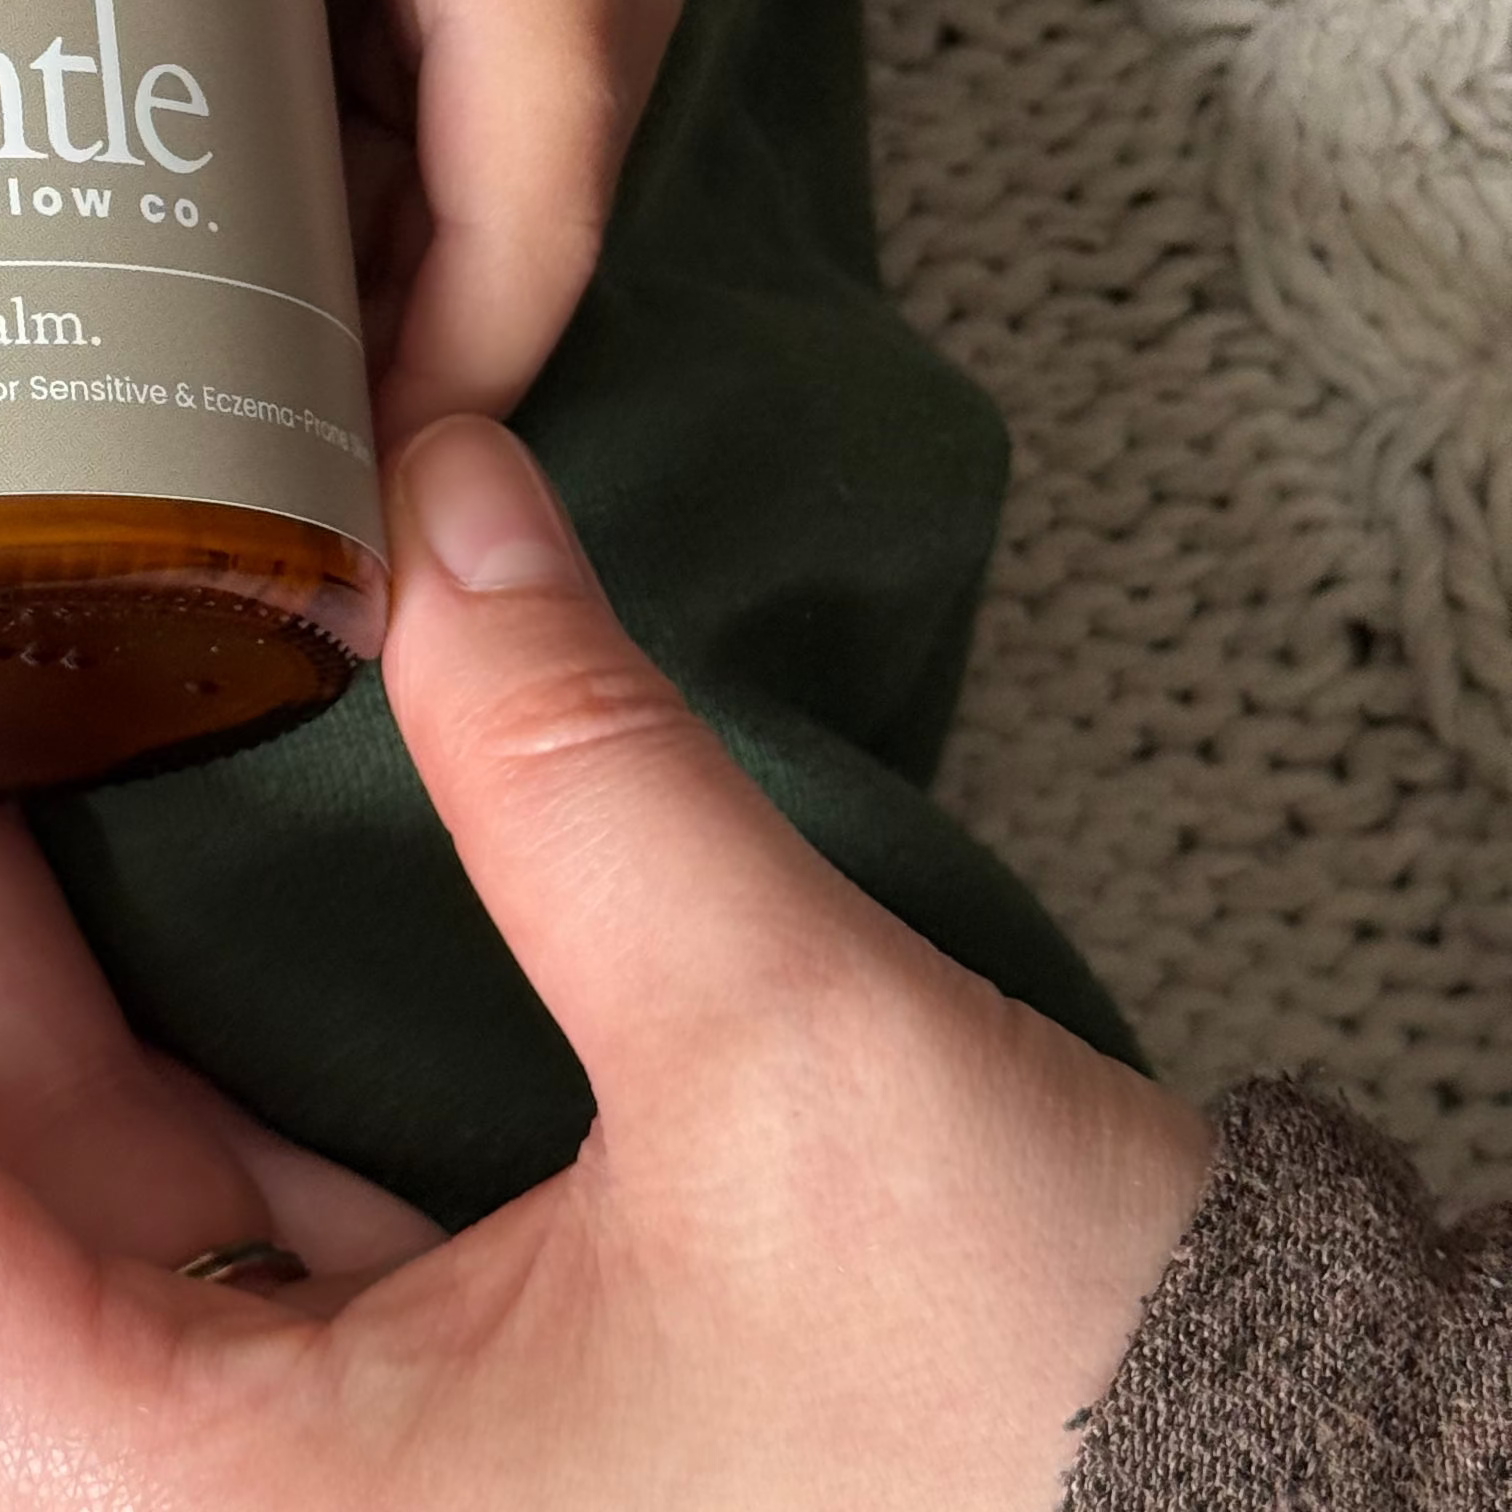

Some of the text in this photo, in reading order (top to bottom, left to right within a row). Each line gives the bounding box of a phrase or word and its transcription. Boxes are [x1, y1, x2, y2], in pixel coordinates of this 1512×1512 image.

[140, 193, 219, 233] co.
[29, 373, 169, 405] Sensitive
[175, 382, 198, 410] &
